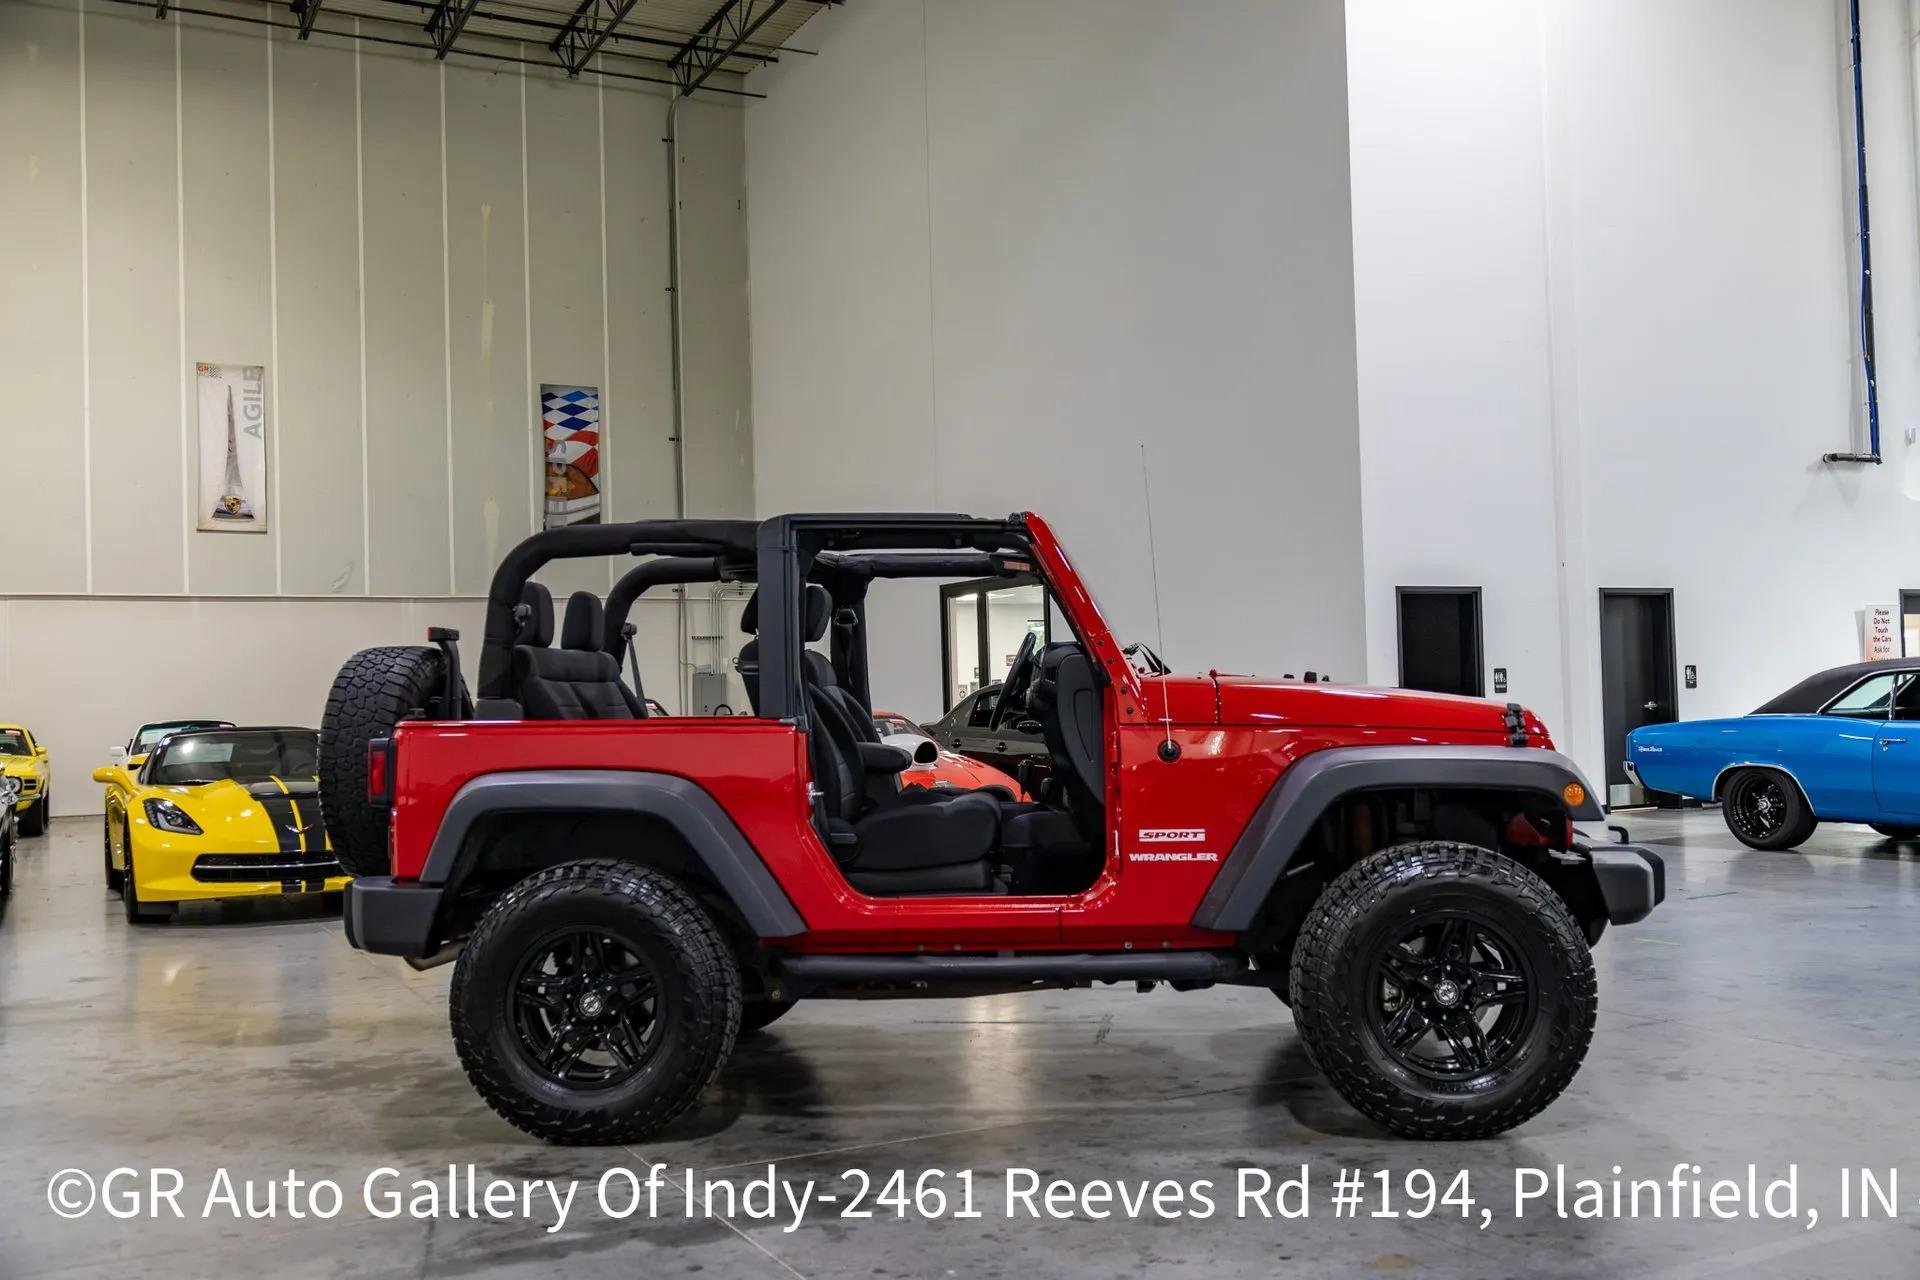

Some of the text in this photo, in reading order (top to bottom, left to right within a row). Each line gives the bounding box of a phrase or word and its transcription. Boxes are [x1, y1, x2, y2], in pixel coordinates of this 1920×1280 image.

[243, 367, 262, 439] AGILE
[1140, 830, 1205, 840] SPORT
[1129, 853, 1218, 861] WRANGLER
